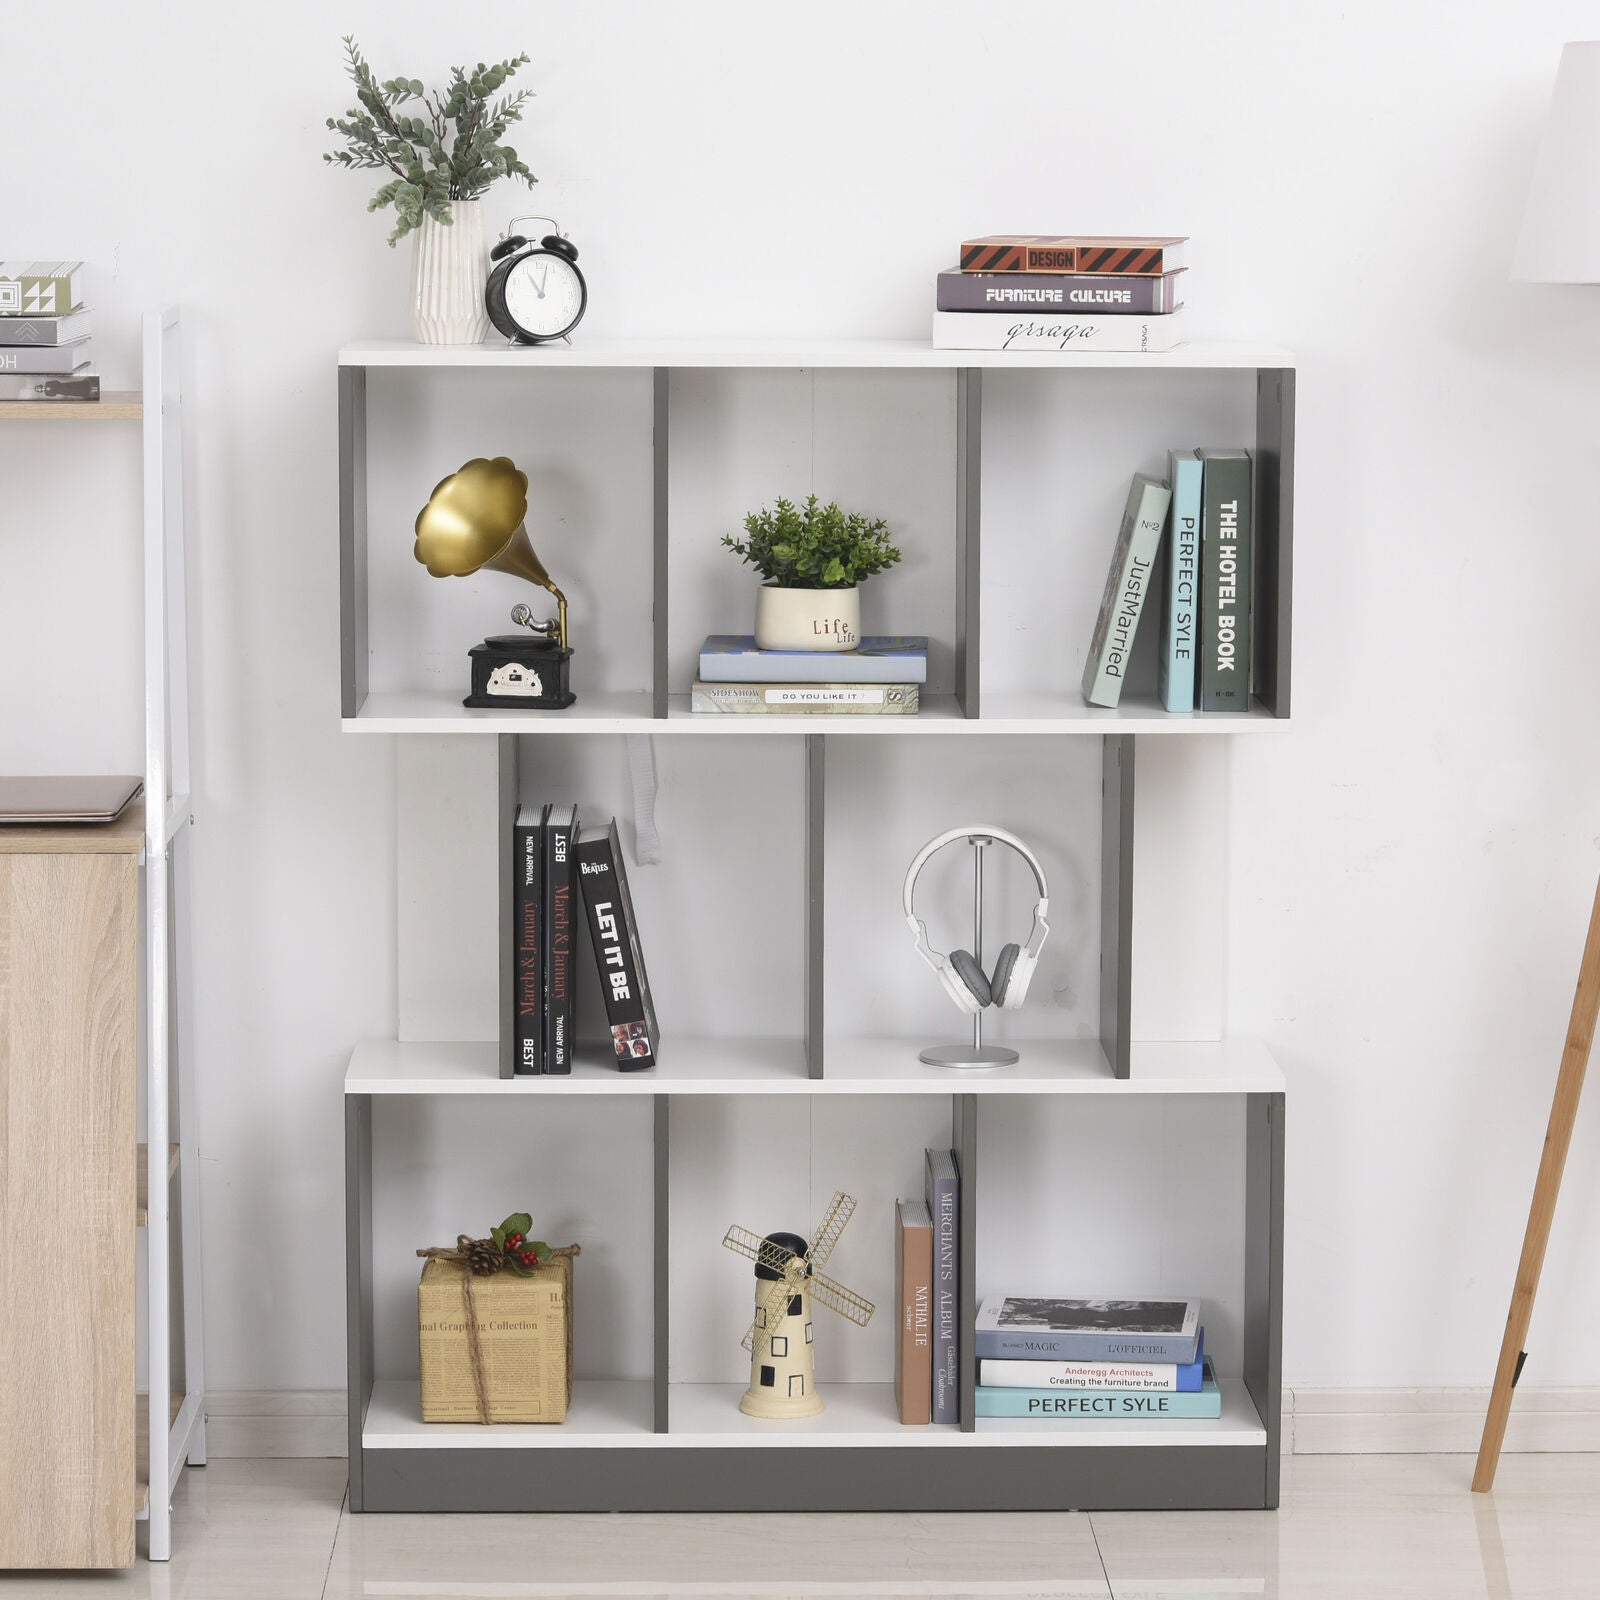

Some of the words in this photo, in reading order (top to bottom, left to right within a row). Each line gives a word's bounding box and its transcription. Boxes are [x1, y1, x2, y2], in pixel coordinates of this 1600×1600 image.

[1029, 251, 1074, 268] DESIGN
[1069, 289, 1132, 304] CULTURE
[1219, 499, 1238, 540] THE
[1177, 517, 1196, 607] PERFECT
[1218, 545, 1237, 610] HOTEL
[813, 619, 848, 634] Life
[1105, 556, 1151, 678] JustMarried
[837, 633, 855, 643] Life
[1175, 612, 1191, 659] SYLE
[1217, 615, 1236, 671] BOOK
[711, 689, 760, 697] SIDESHOW
[525, 835, 534, 852] NEW
[555, 832, 566, 863] BEST
[525, 853, 534, 886] ARRIVAL
[554, 885, 570, 929] March
[594, 901, 619, 942] LET
[520, 900, 538, 954] January
[554, 933, 570, 945] &
[520, 956, 536, 967] &
[603, 945, 624, 967] IT
[554, 947, 569, 999] January
[609, 970, 631, 1002] BE
[520, 972, 536, 1016] March
[555, 1014, 564, 1046] ARRIVAL
[523, 1038, 534, 1068] BEST
[555, 1047, 564, 1065] NEW
[940, 1192, 953, 1281] MERCHANTS
[489, 1320, 538, 1331] Collection
[914, 1286, 929, 1347] NATHALIE
[940, 1290, 953, 1339] ALBUM
[1025, 1341, 1060, 1352] MAGIC
[1108, 1344, 1167, 1355] L'OFFICIEL
[1049, 1376, 1086, 1387] Creating
[1088, 1378, 1102, 1386] the
[1104, 1378, 1142, 1387] furniture
[1143, 1379, 1169, 1388] brand
[1065, 1367, 1107, 1377] Anderegg
[1109, 1367, 1154, 1377] Architects
[1028, 1398, 1117, 1413] PERFECT
[1122, 1397, 1169, 1412] SYLE
